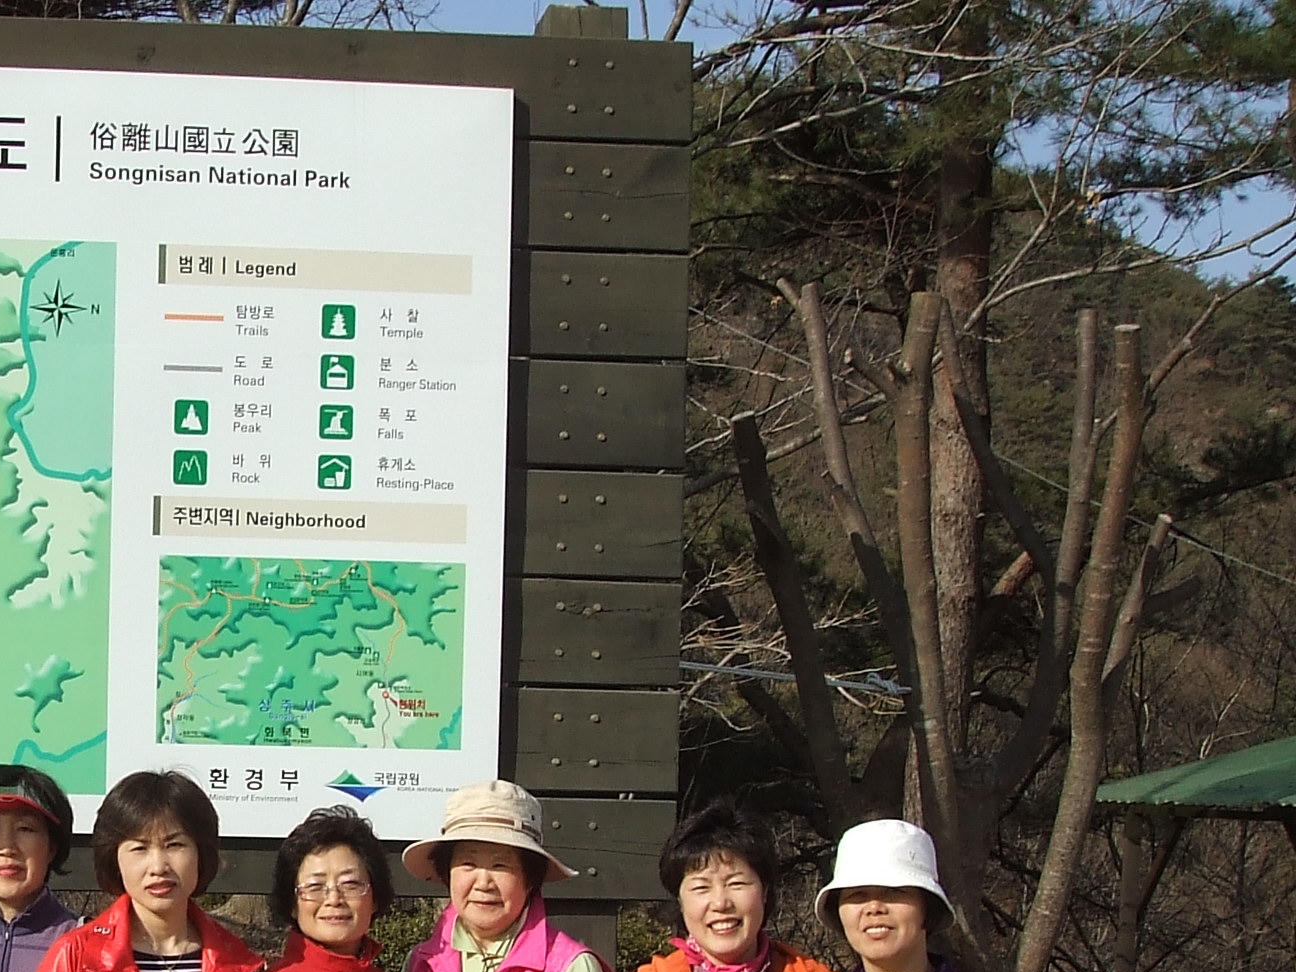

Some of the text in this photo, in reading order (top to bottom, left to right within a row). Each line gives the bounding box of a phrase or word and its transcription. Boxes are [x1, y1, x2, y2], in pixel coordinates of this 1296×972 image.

[91, 122, 298, 157] 俗離山國立公園
[90, 162, 349, 188] Songnisan National Park
[236, 260, 295, 278] Legend
[91, 305, 100, 315] N
[237, 305, 274, 319] 탐방로
[235, 323, 269, 337] Trails
[379, 327, 423, 341] Temple
[233, 374, 265, 387] Road
[378, 378, 456, 393] Ranger Station
[234, 403, 272, 418] 봉우리
[233, 421, 262, 434] Peak
[377, 427, 404, 441] Falls
[378, 457, 415, 471] 휴게소
[232, 471, 261, 484] Rock
[376, 477, 455, 491] Resting-Place
[173, 507, 365, 529] 주변지역 Neighborhood
[209, 768, 299, 791] 환경부
[374, 772, 420, 785] 국립공원
[209, 793, 298, 804] Ministry of Environment
